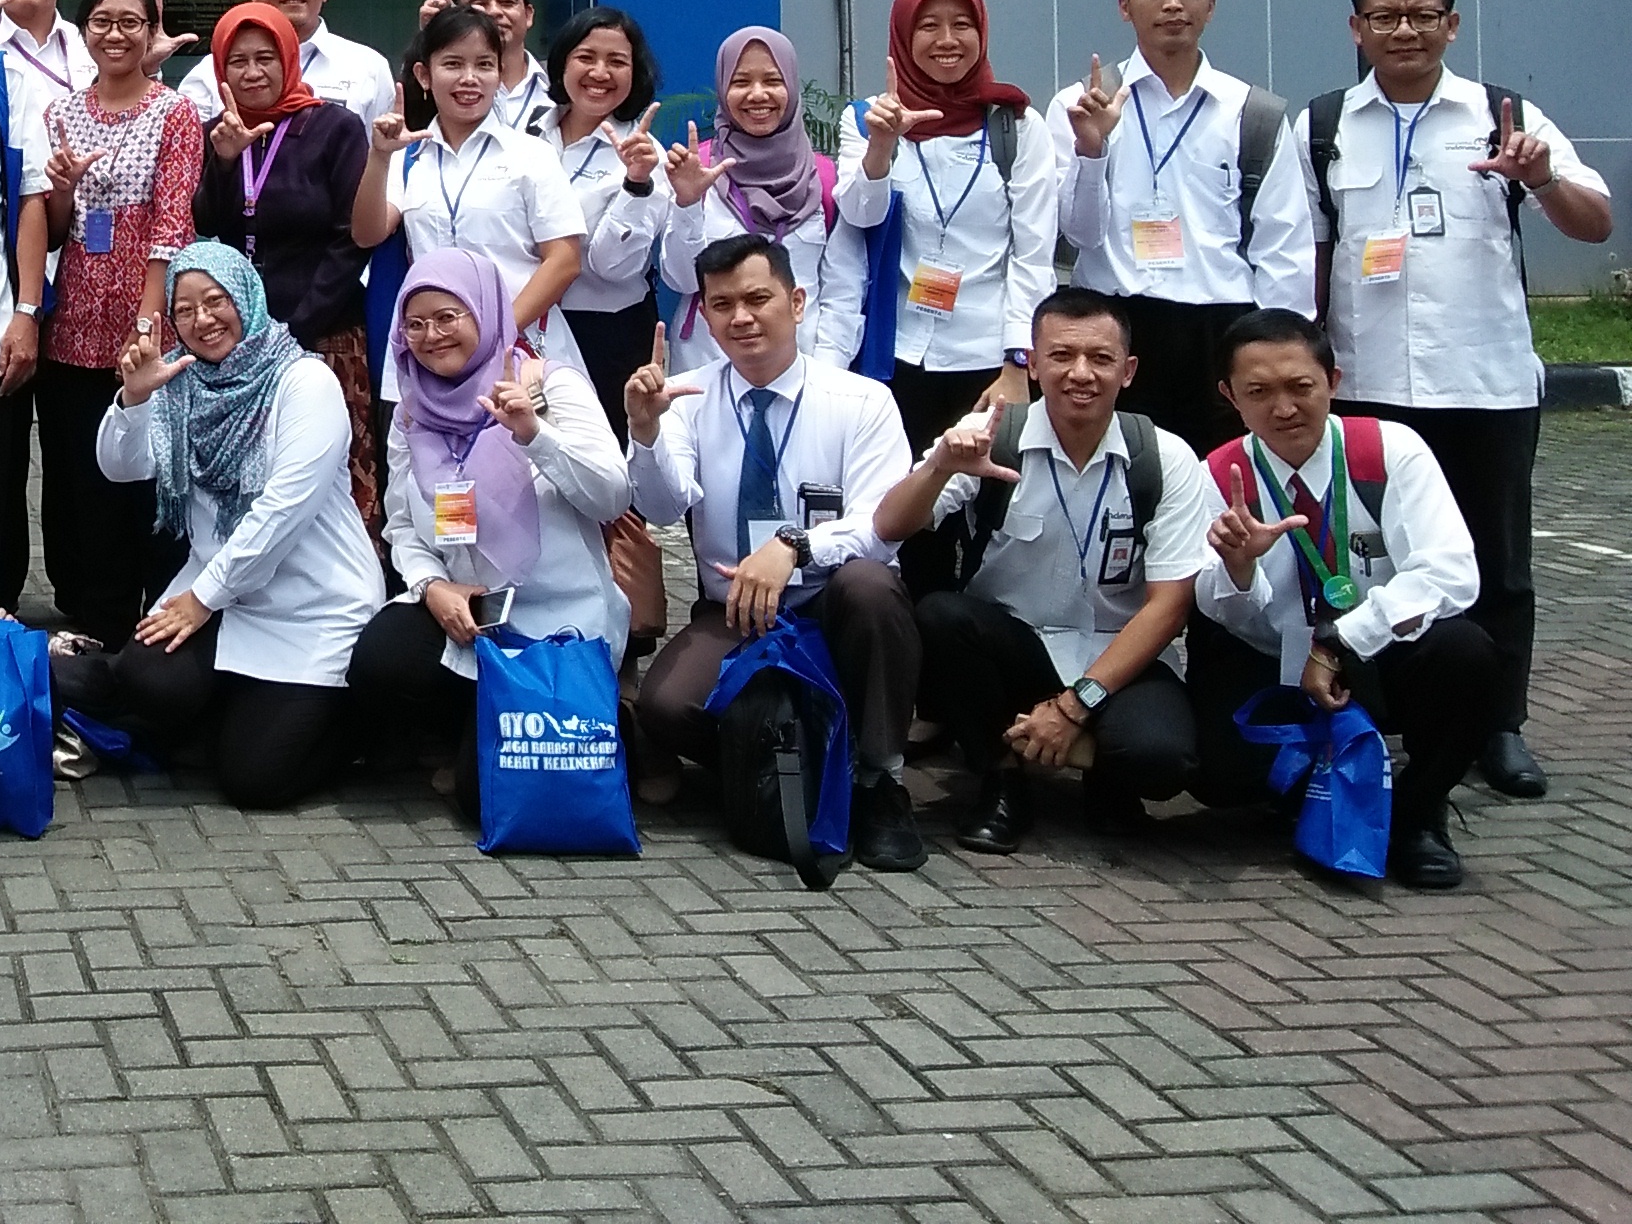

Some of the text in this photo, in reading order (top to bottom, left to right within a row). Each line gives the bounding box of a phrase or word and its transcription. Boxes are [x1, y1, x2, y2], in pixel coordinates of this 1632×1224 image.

[915, 305, 942, 317] PESERTA
[498, 711, 545, 738] AYO
[499, 740, 618, 755] JAGA BAHASA NEGARA
[499, 754, 539, 770] REKAT
